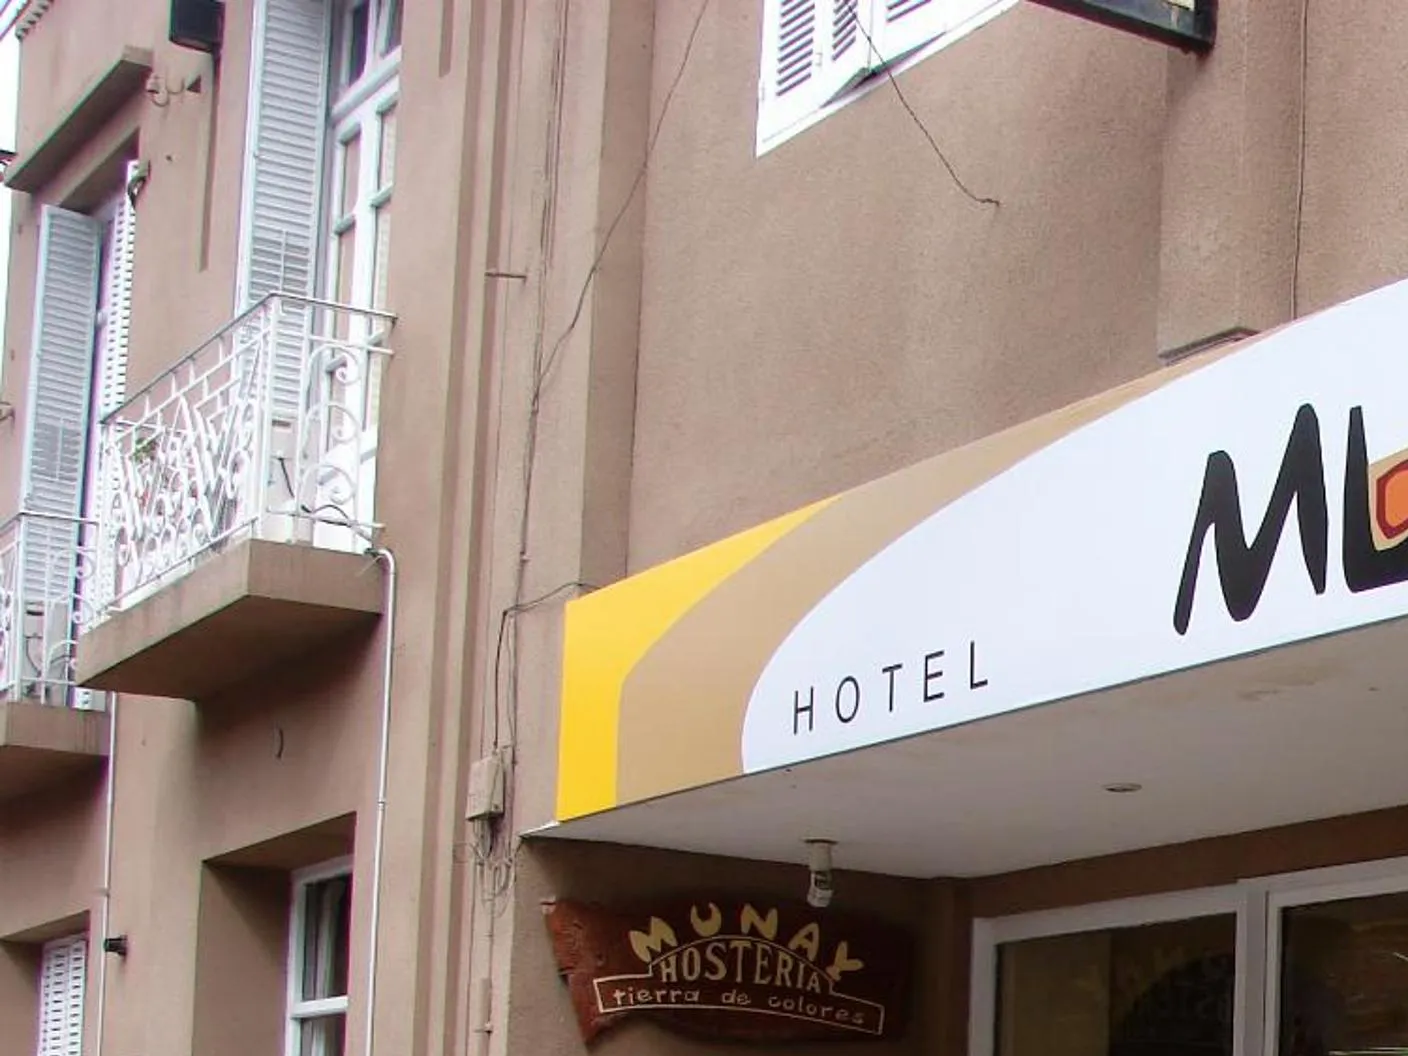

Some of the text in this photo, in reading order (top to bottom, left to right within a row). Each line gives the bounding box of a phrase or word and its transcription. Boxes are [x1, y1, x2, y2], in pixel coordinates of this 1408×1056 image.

[793, 640, 988, 735] HOTEL
[629, 902, 864, 981] MUNAY
[659, 941, 822, 994] HOSTERIA
[613, 986, 866, 1026] tierra de colores
